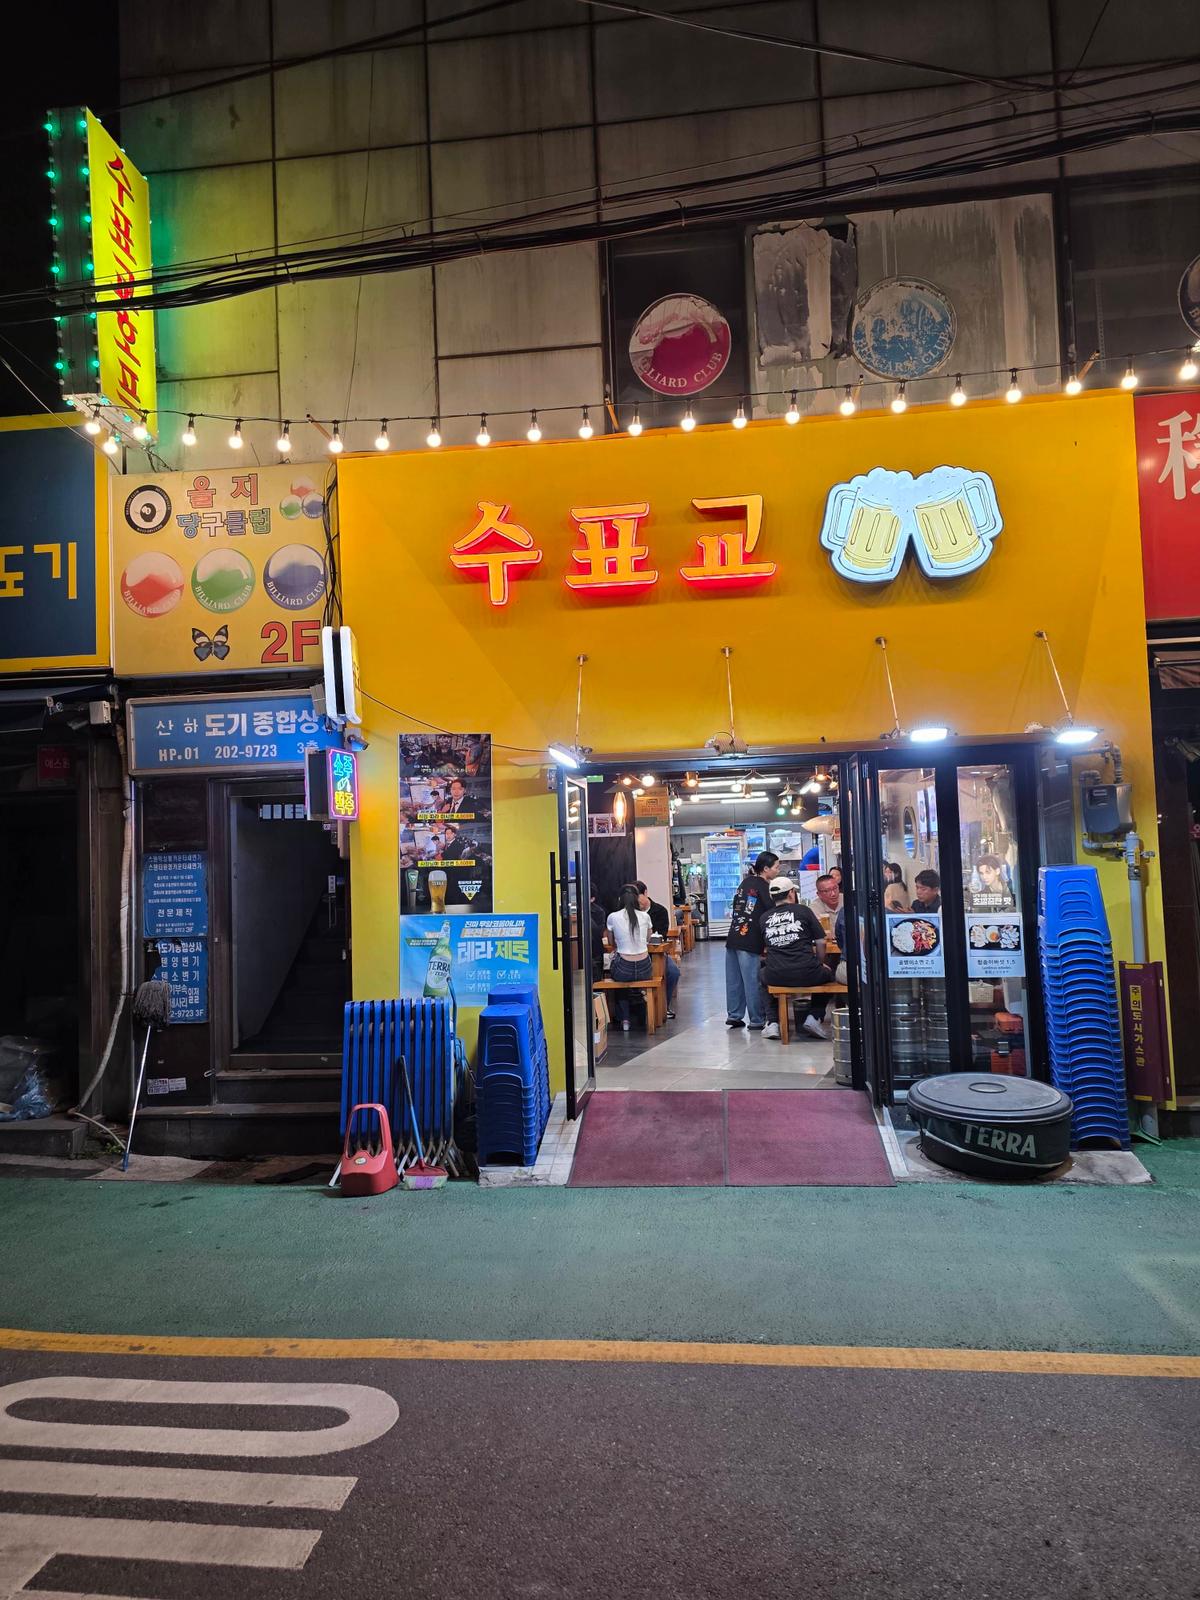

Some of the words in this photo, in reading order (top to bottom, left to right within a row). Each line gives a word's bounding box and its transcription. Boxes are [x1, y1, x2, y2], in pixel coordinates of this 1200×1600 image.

[922, 332, 951, 364] CLUB
[694, 352, 722, 383] CLUB
[176, 508, 271, 538] 당구클럽
[449, 494, 777, 605] 수표교
[195, 586, 231, 611] BILLIARD
[266, 581, 303, 606] BILLIARD
[306, 580, 325, 601] CLUB
[260, 620, 321, 664] 2F
[159, 747, 199, 762] HP.01
[215, 744, 277, 759] 202-9723
[458, 941, 493, 964] 테라
[495, 940, 529, 964] 제로
[960, 1122, 1036, 1158] TERRA
